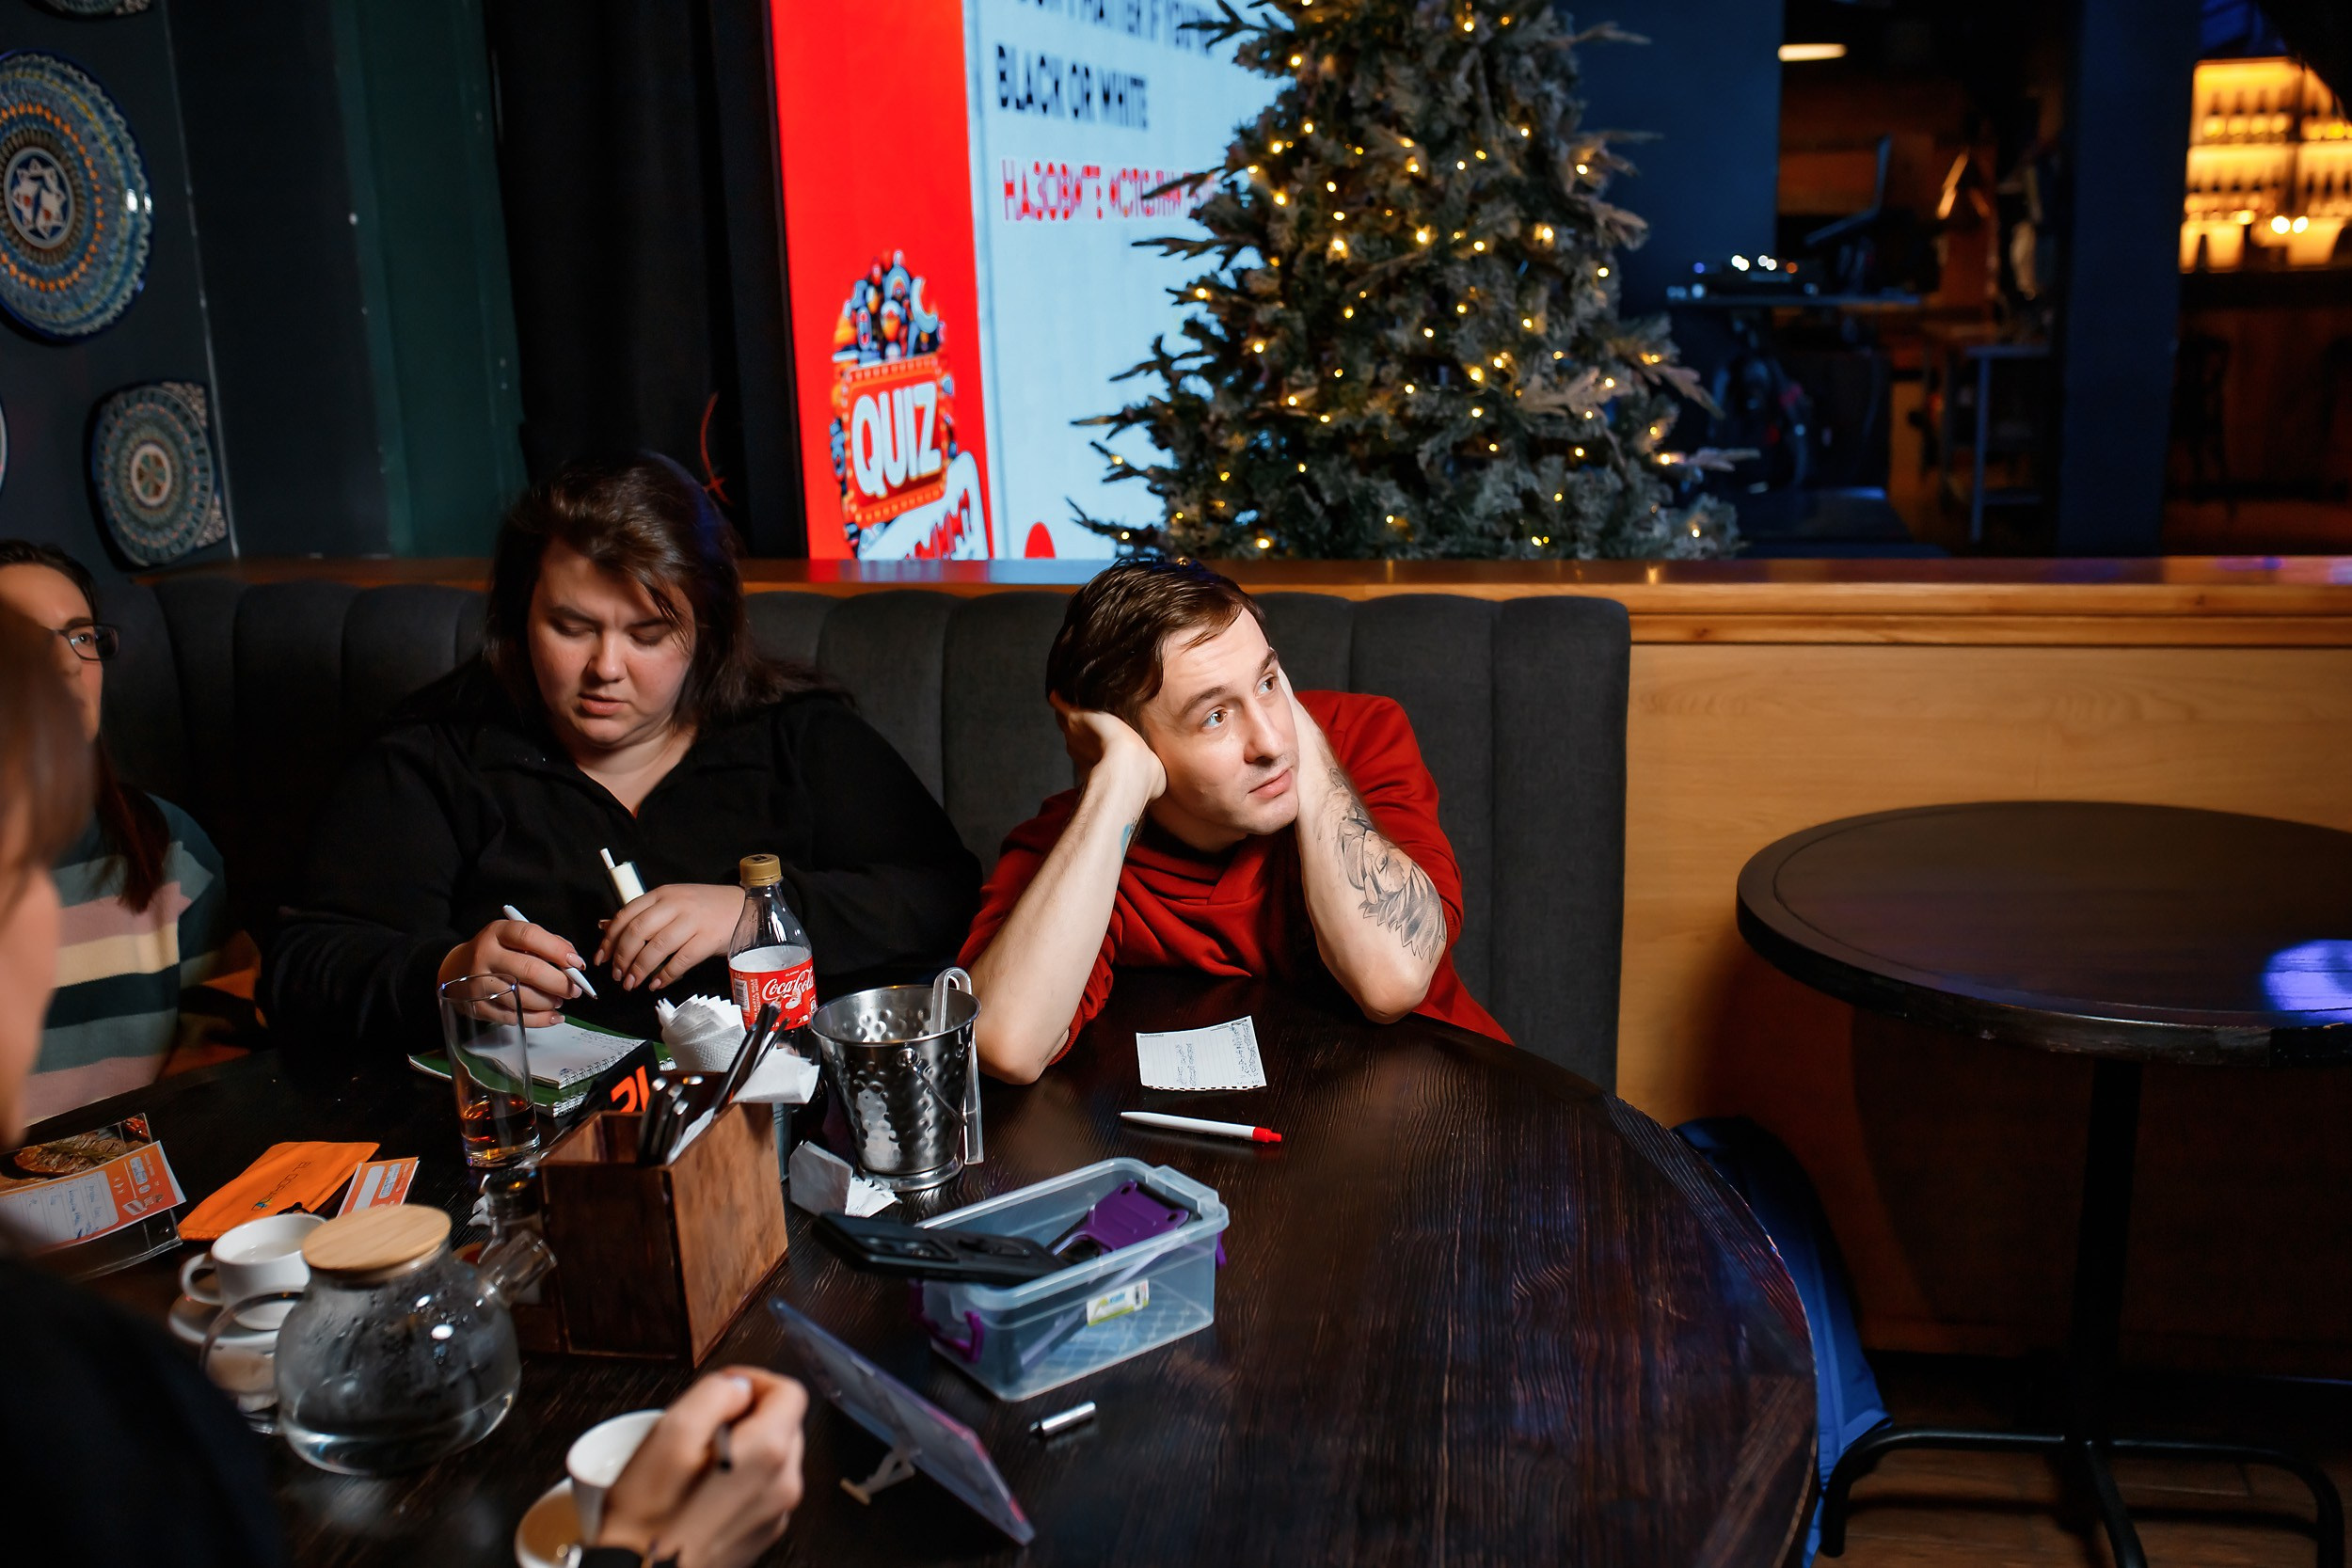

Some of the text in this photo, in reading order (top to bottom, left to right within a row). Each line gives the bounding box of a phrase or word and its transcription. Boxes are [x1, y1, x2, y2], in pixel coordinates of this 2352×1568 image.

[996, 43, 1148, 131] BLACK OR WHITE
[852, 382, 941, 498] QUIZ
